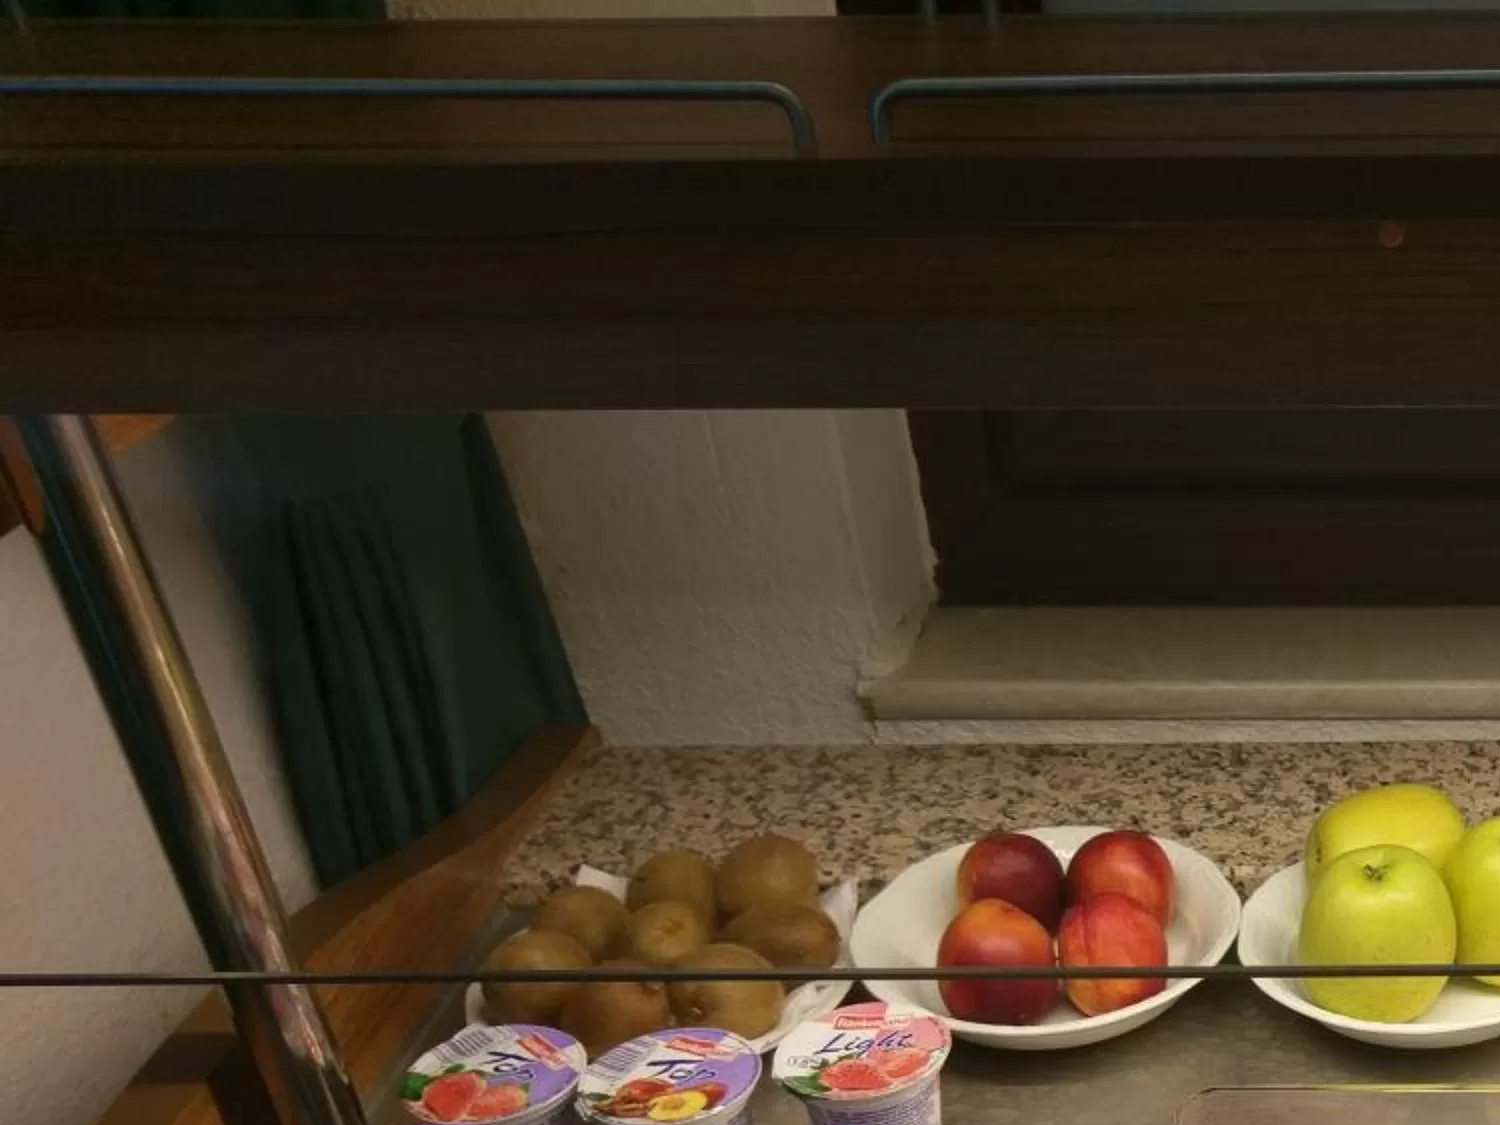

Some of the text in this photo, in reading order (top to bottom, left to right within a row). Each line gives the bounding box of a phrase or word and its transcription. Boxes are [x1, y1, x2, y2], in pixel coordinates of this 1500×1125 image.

[813, 1030, 913, 1058] Light
[479, 1051, 537, 1081] Top
[647, 1059, 717, 1087] Top
